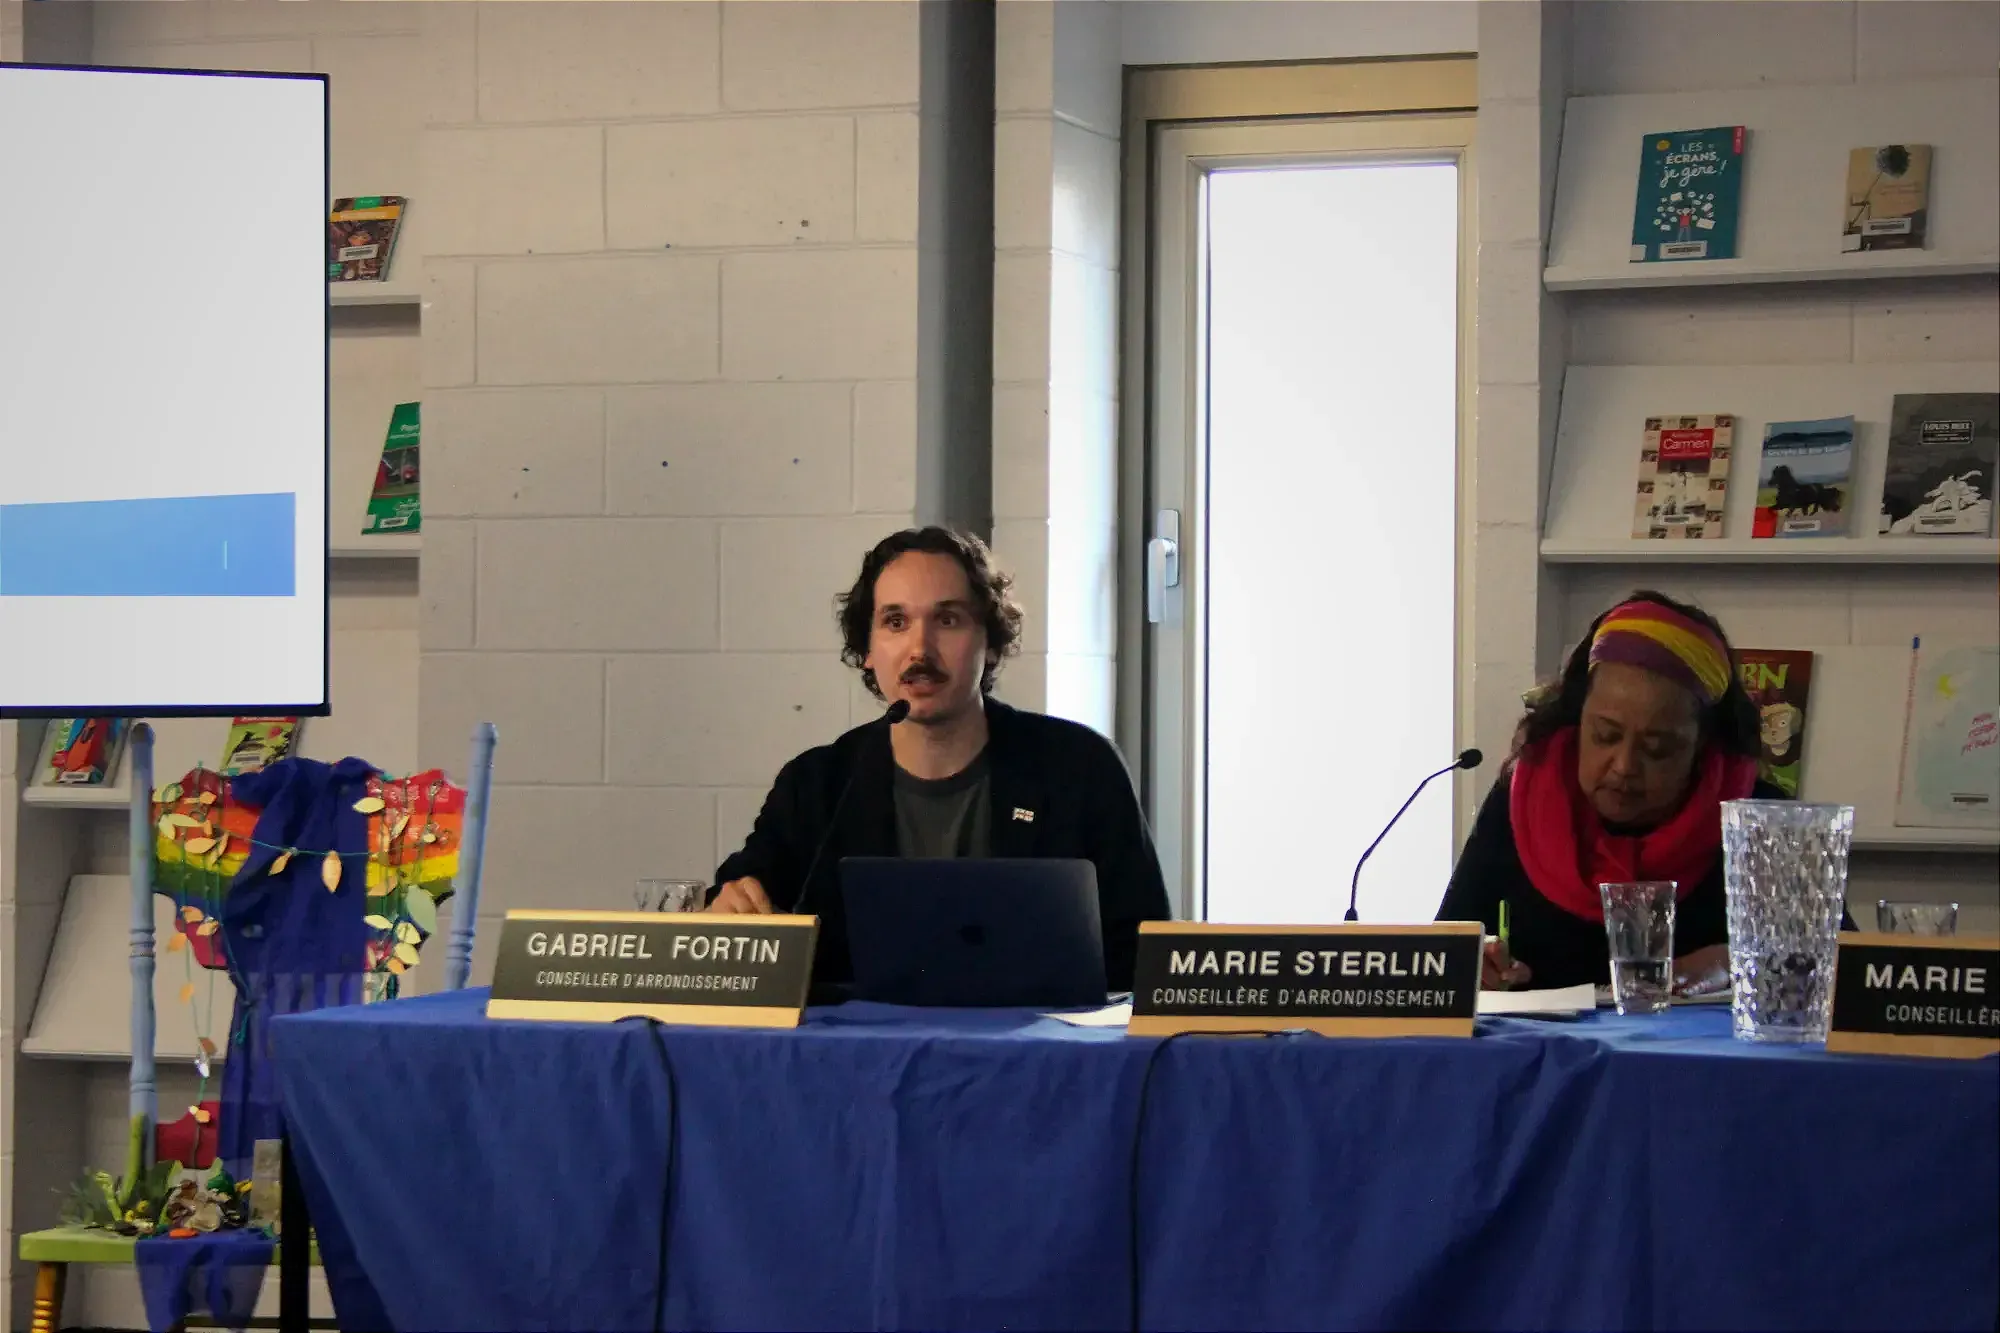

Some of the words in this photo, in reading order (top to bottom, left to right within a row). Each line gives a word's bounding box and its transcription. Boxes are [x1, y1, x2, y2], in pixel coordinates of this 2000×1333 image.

[1681, 141, 1703, 152] LES
[1660, 166, 1679, 188] je
[1663, 437, 1710, 450] Carmen
[526, 931, 653, 959] GABRIEL
[672, 935, 781, 964] FORTIN
[1168, 950, 1282, 975] MARIE
[1294, 950, 1447, 976] STERLIN
[536, 970, 619, 987] CONSEILLER
[623, 972, 759, 991] D'ARRONDISSEMENT
[1864, 962, 1988, 994] MARIE
[1152, 985, 1269, 1006] CONSEILLÈRE
[1279, 988, 1456, 1007] D'ARRONDISSEMENT
